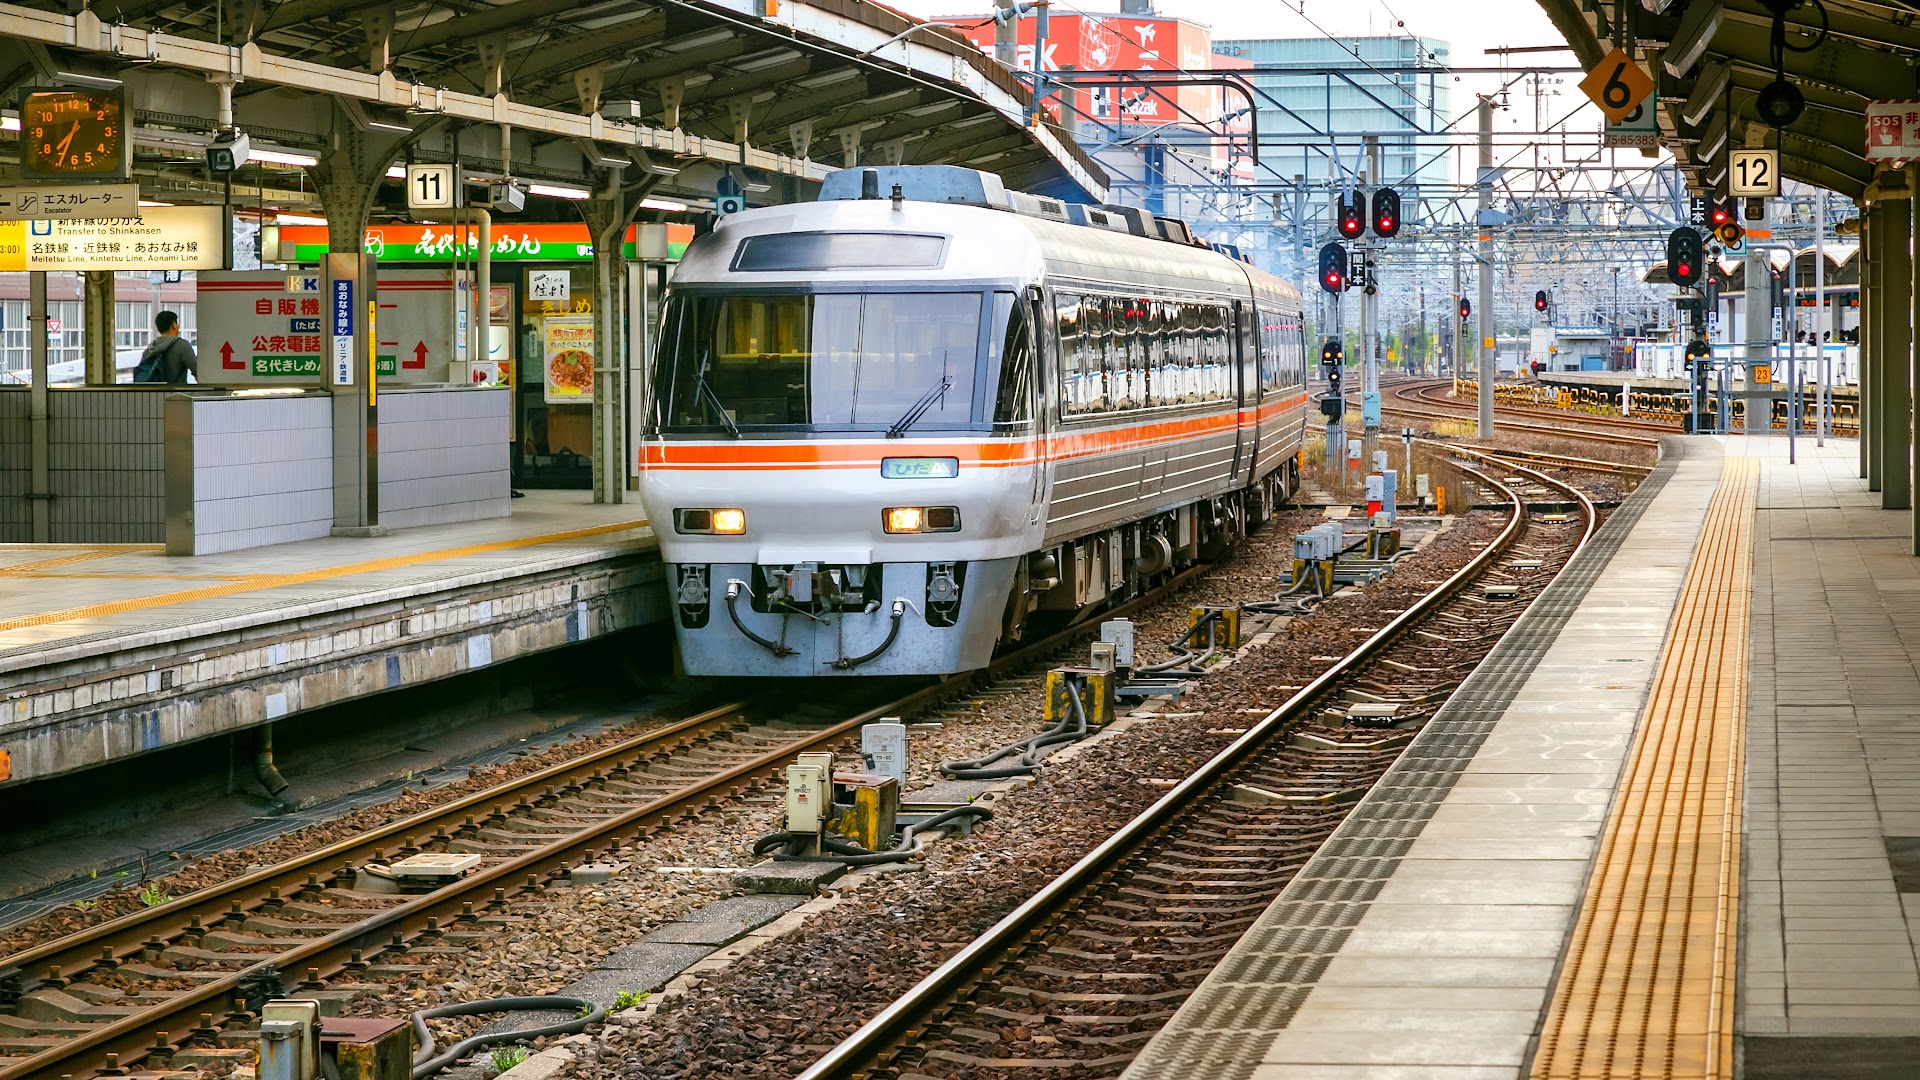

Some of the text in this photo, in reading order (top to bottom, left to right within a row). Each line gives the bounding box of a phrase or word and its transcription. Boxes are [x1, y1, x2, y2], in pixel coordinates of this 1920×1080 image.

[1603, 63, 1630, 108] 6
[54, 103, 64, 112] 11
[68, 100, 79, 109] 12
[84, 102, 90, 112] 1
[42, 112, 52, 122] 10
[97, 110, 104, 121] 2
[1874, 117, 1899, 126] SOS
[36, 128, 43, 137] 9
[105, 127, 112, 137] 3
[44, 144, 51, 154] 8
[97, 143, 105, 153] 4
[71, 155, 78, 165] 6
[84, 152, 92, 162] 5
[1736, 158, 1769, 187] 12
[417, 173, 440, 200] 11
[44, 193, 123, 204] エスカレーター
[1692, 201, 1704, 223] 上本
[32, 241, 198, 254] 名鉄線・近鉄線・あおなみ線
[414, 228, 541, 257] 名代きめん
[68, 255, 88, 263] Line,
[126, 255, 146, 263] Line,
[256, 298, 320, 316] 自販機
[338, 283, 348, 327] あおなみ線
[252, 335, 320, 352] 公衆電話
[1757, 370, 1768, 380] 23
[1559, 394, 1570, 403] 45
[894, 463, 929, 475] ひだ
